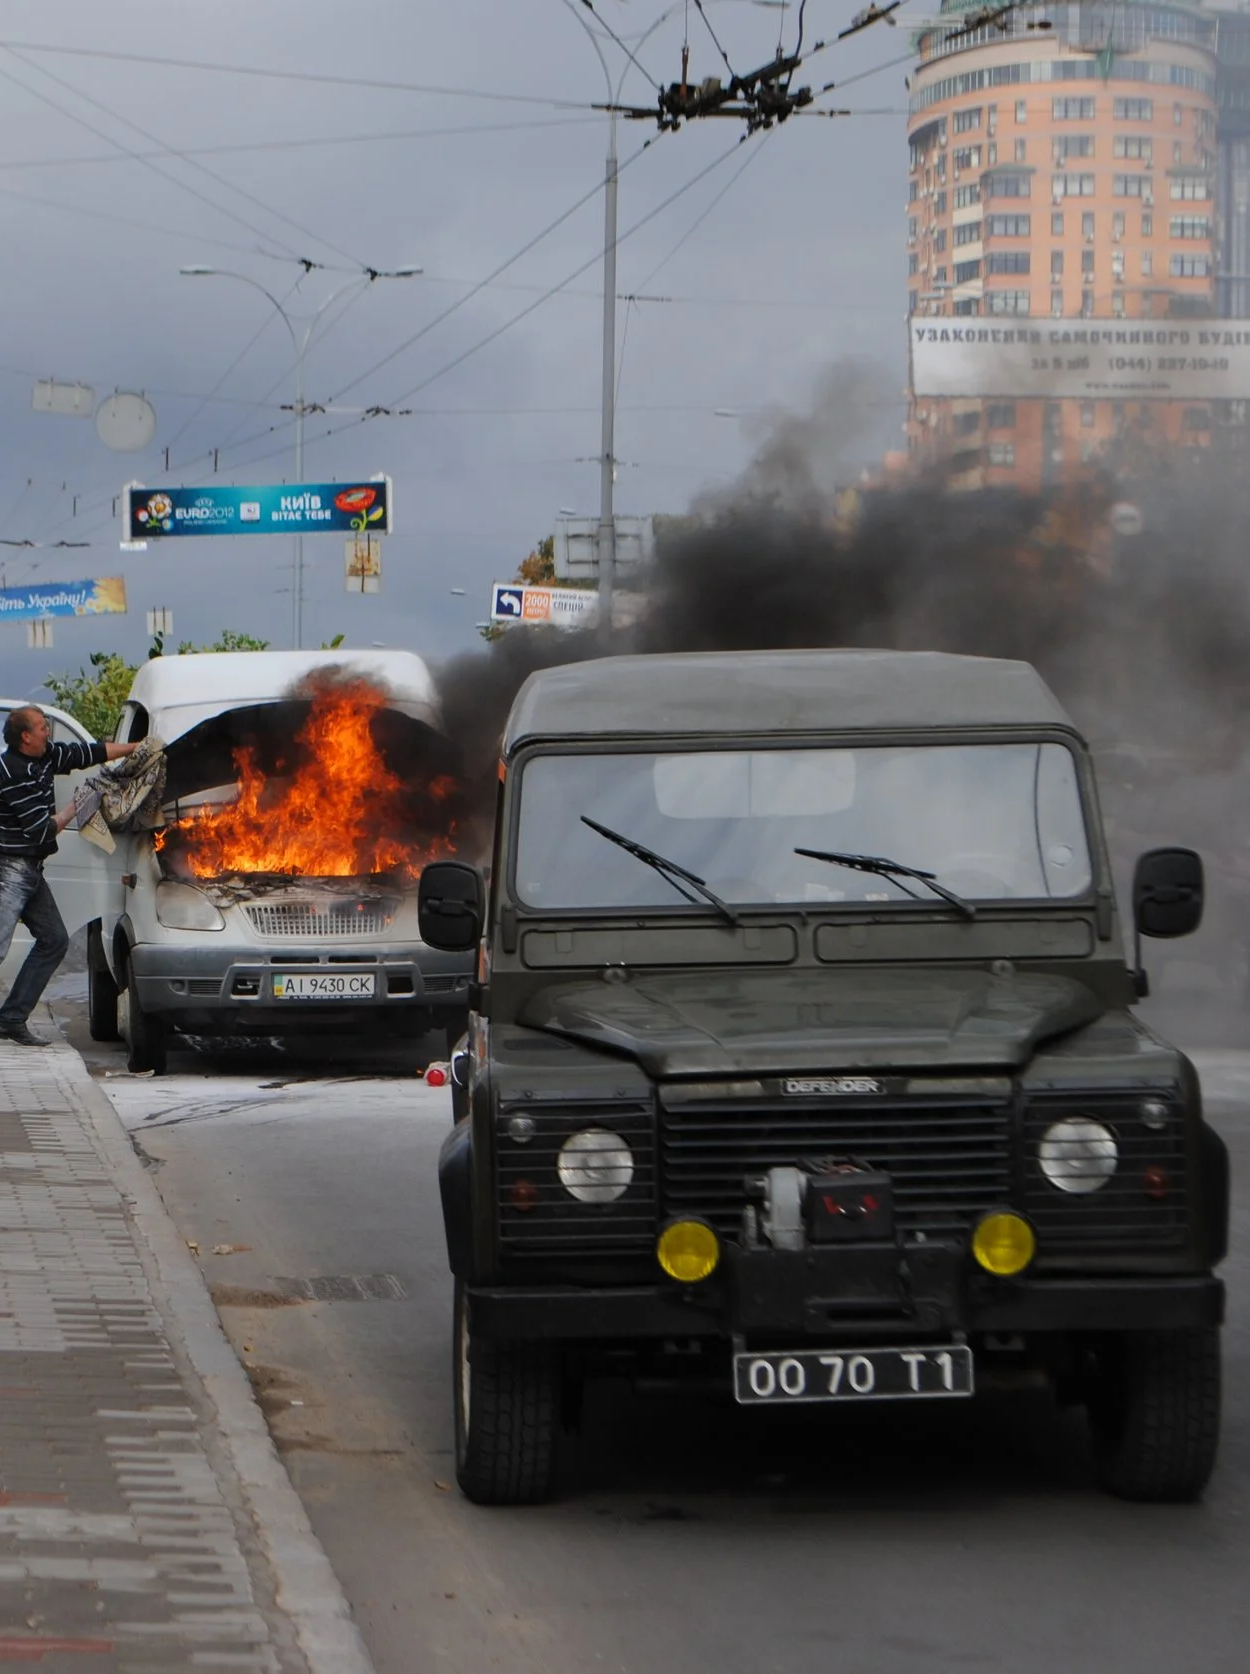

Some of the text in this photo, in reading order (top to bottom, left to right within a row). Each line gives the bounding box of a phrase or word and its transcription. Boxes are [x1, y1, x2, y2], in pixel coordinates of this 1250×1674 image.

[281, 492, 321, 510] КИЇВ
[271, 510, 302, 521] ВІТАЄ
[304, 509, 332, 520] ТЕБЕ
[27, 589, 86, 616] Україну!
[525, 594, 548, 607] 2000
[285, 977, 371, 993] AI 9430 CK
[786, 1079, 879, 1094] DEFENDER
[749, 1352, 954, 1397] 00 70 T1
